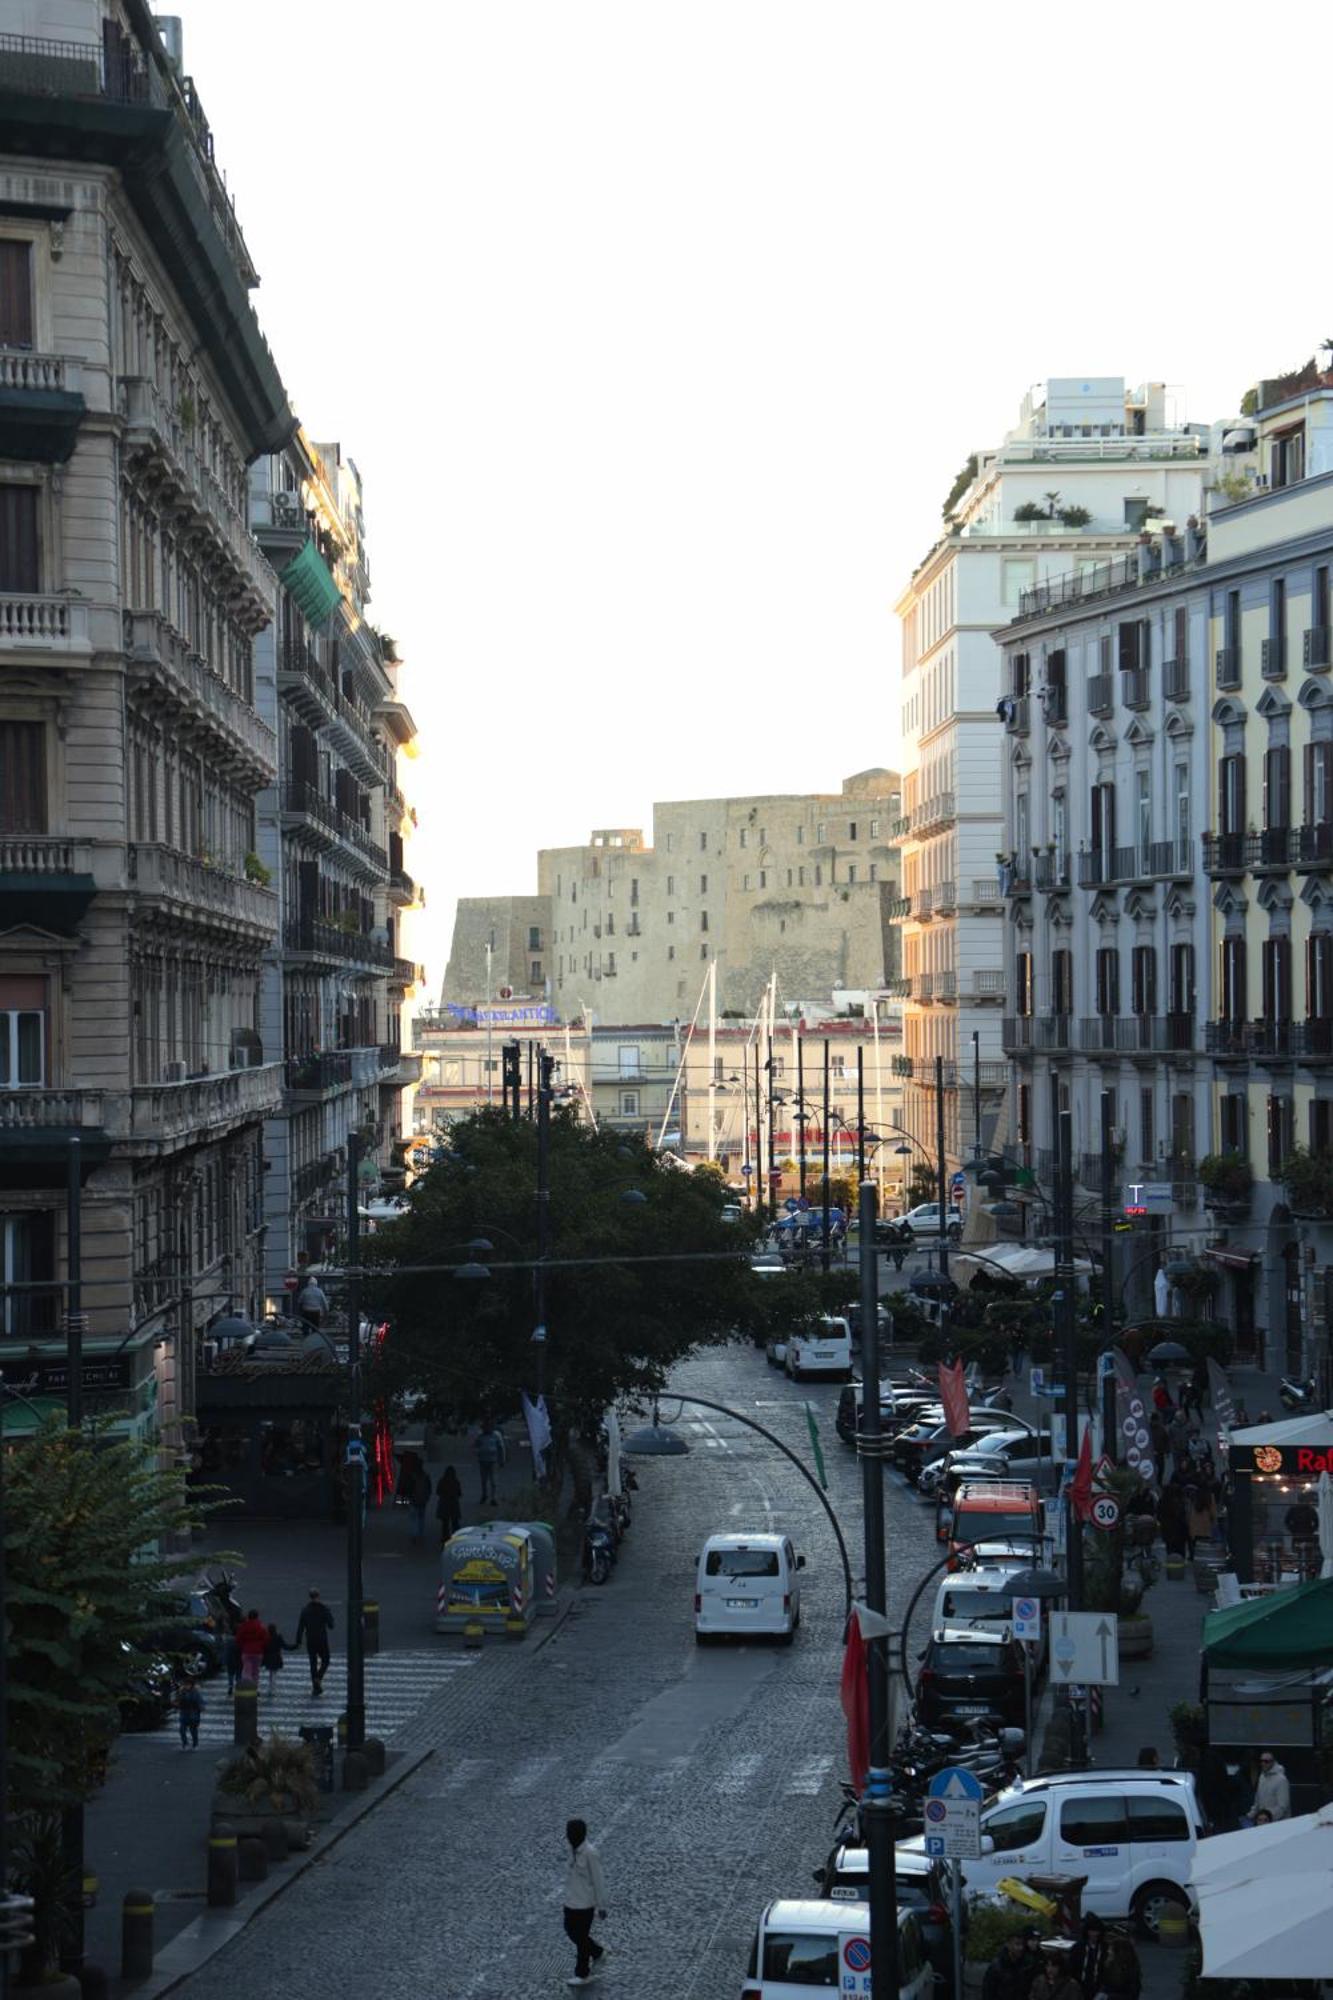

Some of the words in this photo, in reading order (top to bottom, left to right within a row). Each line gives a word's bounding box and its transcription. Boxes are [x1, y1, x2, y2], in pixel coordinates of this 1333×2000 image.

[1128, 1184, 1144, 1204] T
[1097, 1504, 1116, 1519] 30
[930, 1838, 943, 1855] P
[844, 1976, 855, 1990] P
